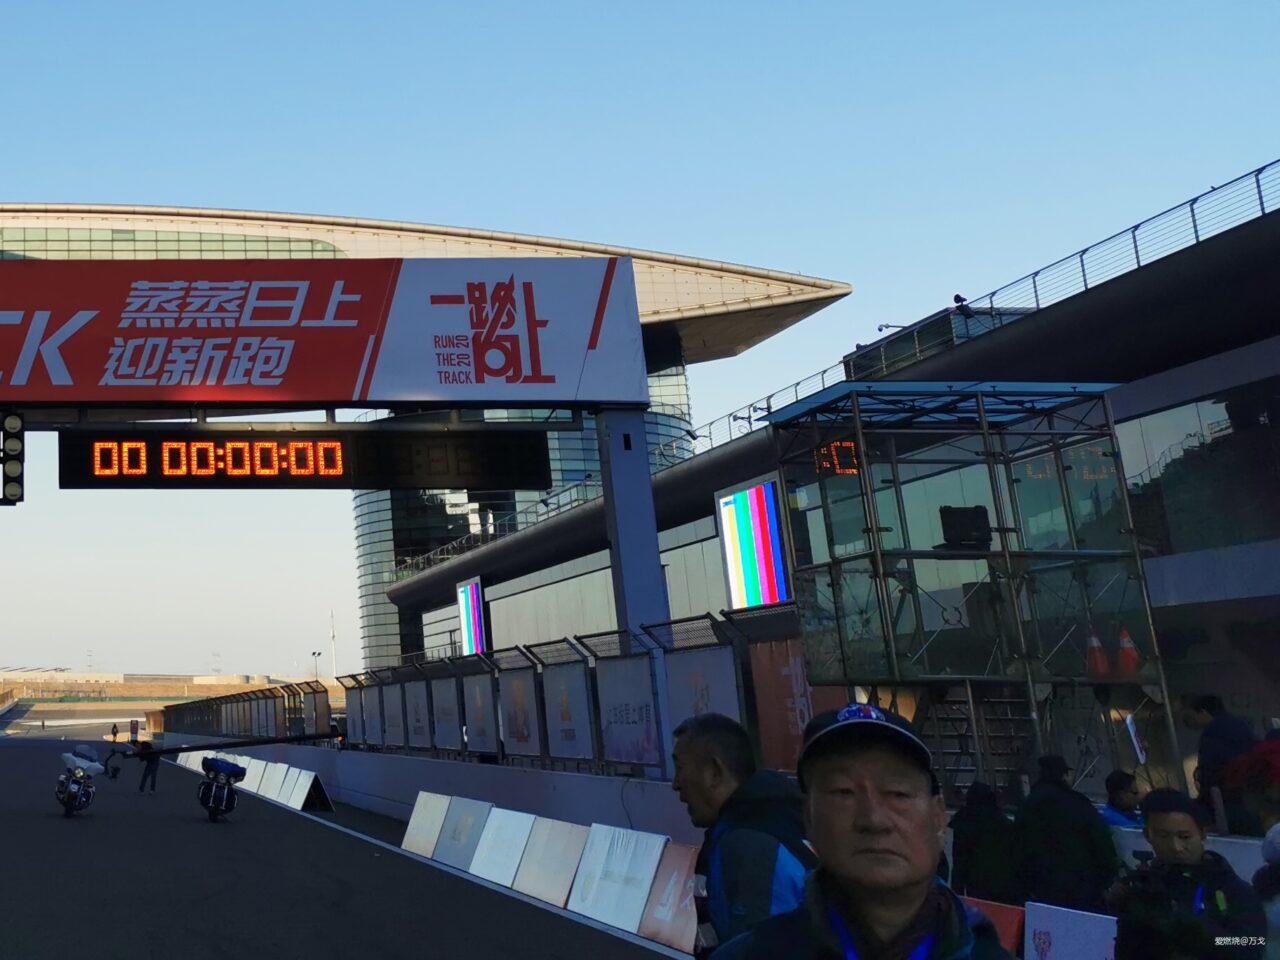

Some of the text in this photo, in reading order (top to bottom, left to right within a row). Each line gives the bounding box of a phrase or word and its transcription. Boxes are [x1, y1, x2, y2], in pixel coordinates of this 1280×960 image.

[120, 279, 363, 328] 蒸蒸日上
[433, 334, 455, 349] RUN
[96, 337, 296, 387] 迎新跑
[435, 352, 457, 367] THE
[437, 370, 472, 385] TRACK
[93, 441, 344, 476] 00 00:00:00
